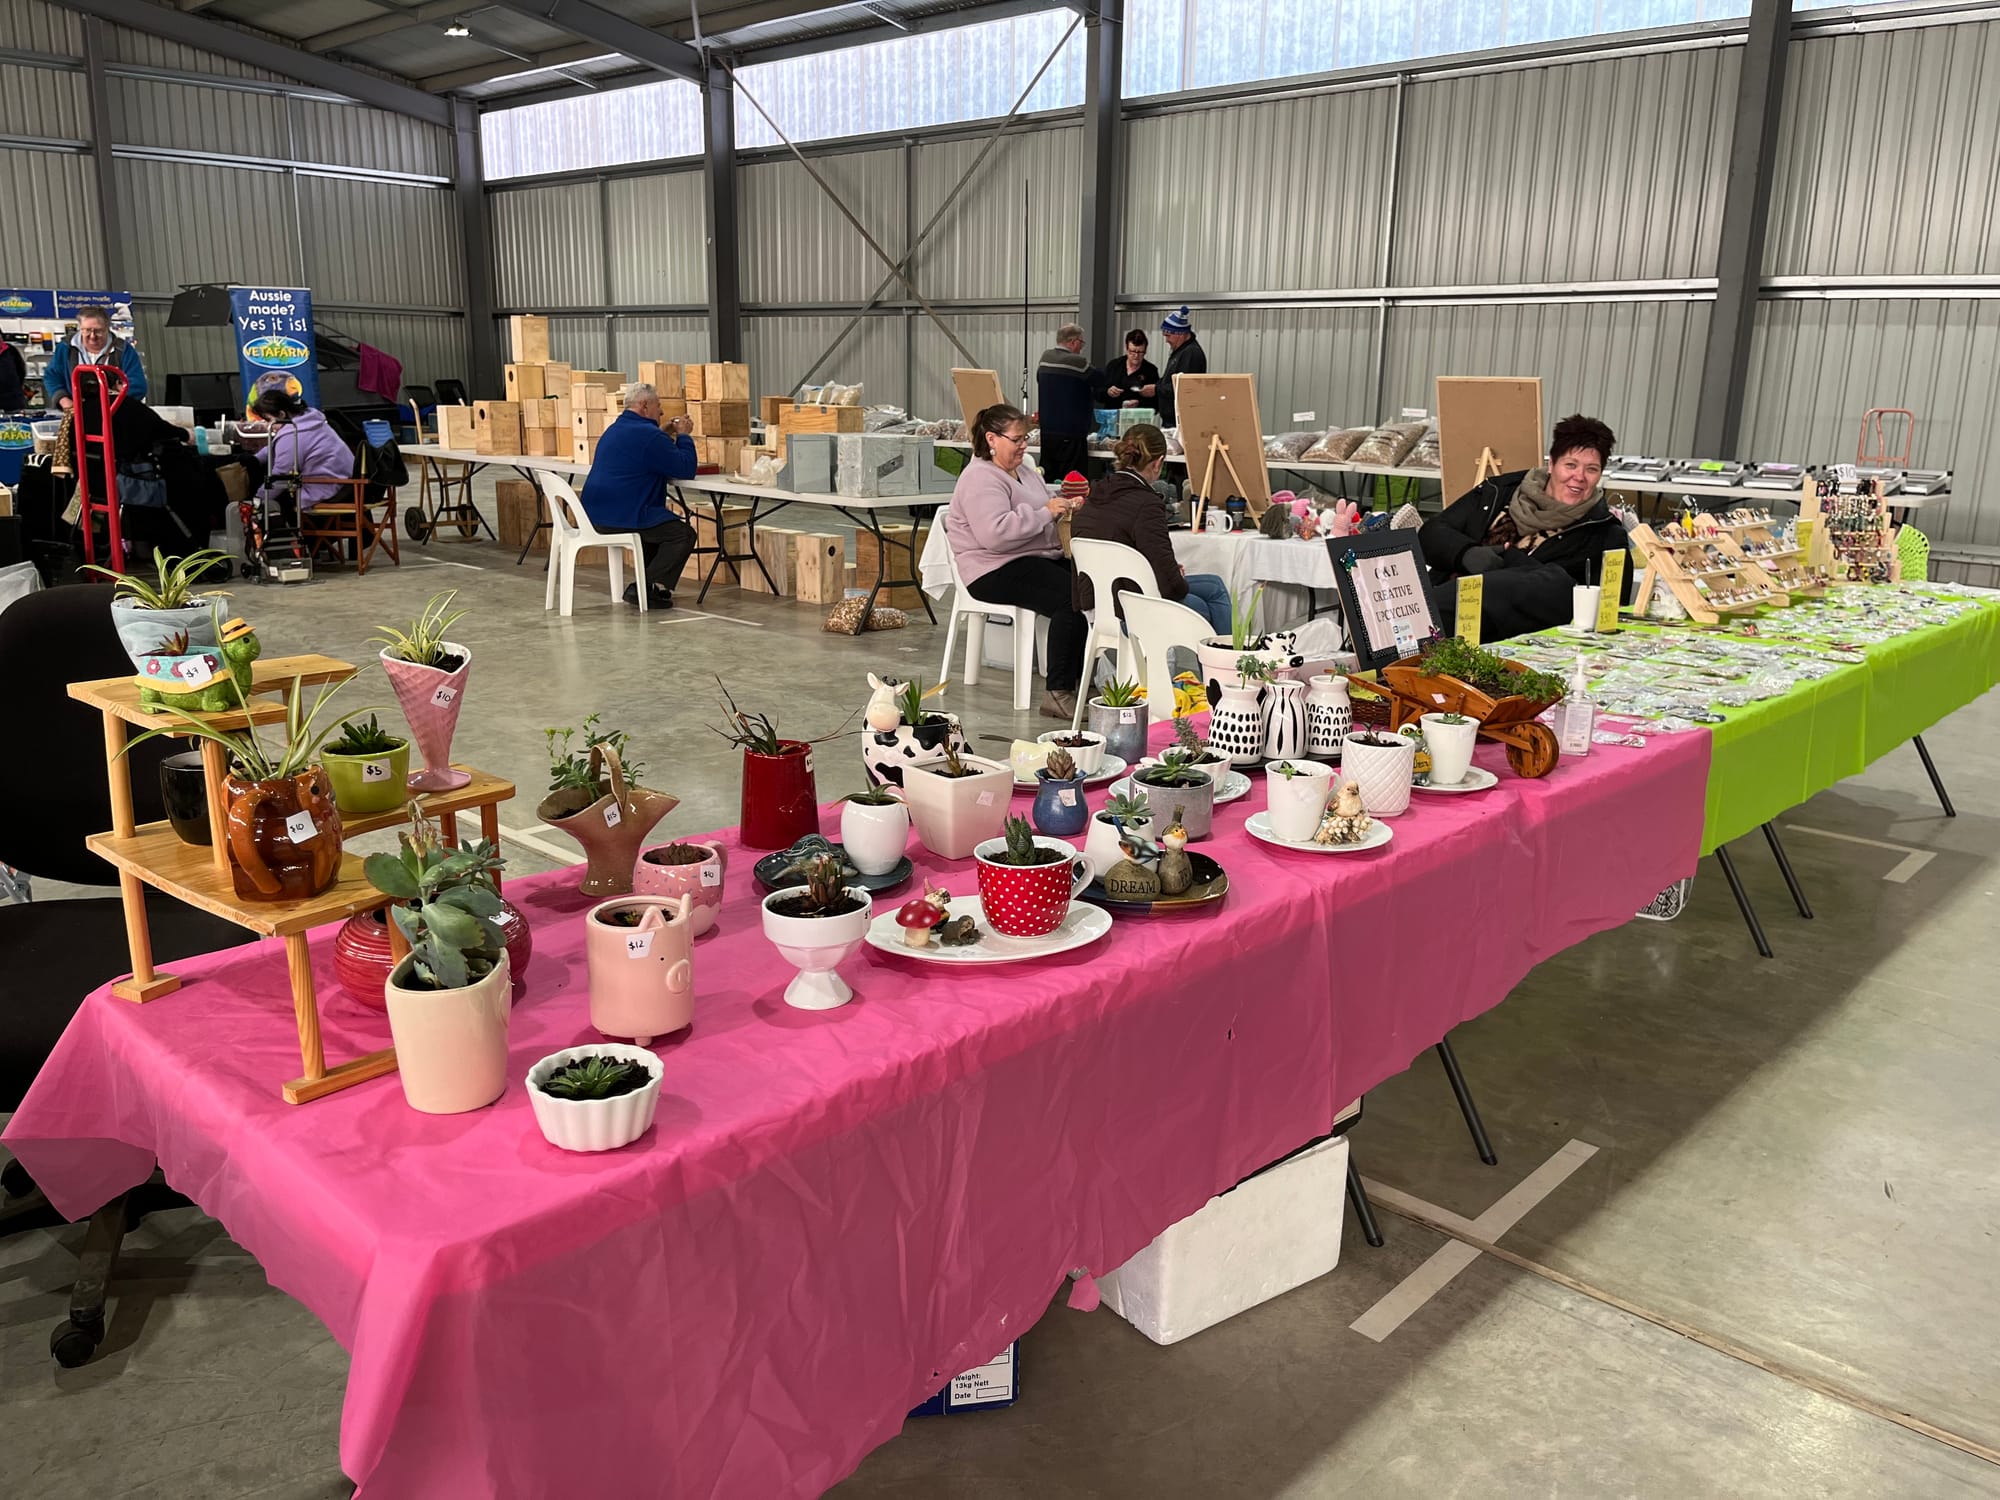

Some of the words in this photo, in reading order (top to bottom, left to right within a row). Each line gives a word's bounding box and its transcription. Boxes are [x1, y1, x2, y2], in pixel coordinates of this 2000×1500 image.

[249, 290, 292, 302] Aussie
[248, 304, 295, 315] made?
[238, 316, 266, 331] Yes
[271, 317, 282, 331] it
[288, 317, 307, 332] is!
[245, 346, 310, 358] VETAFARM
[1839, 466, 1855, 478] $10
[1373, 584, 1413, 603] CREATIVE
[1376, 603, 1420, 623] UPCYCLING
[436, 690, 451, 702] $10
[366, 765, 383, 776] $5
[1110, 878, 1156, 894] DREAM
[628, 939, 645, 951] $12
[955, 1373, 981, 1382] Weight:
[955, 1392, 971, 1400] Date
